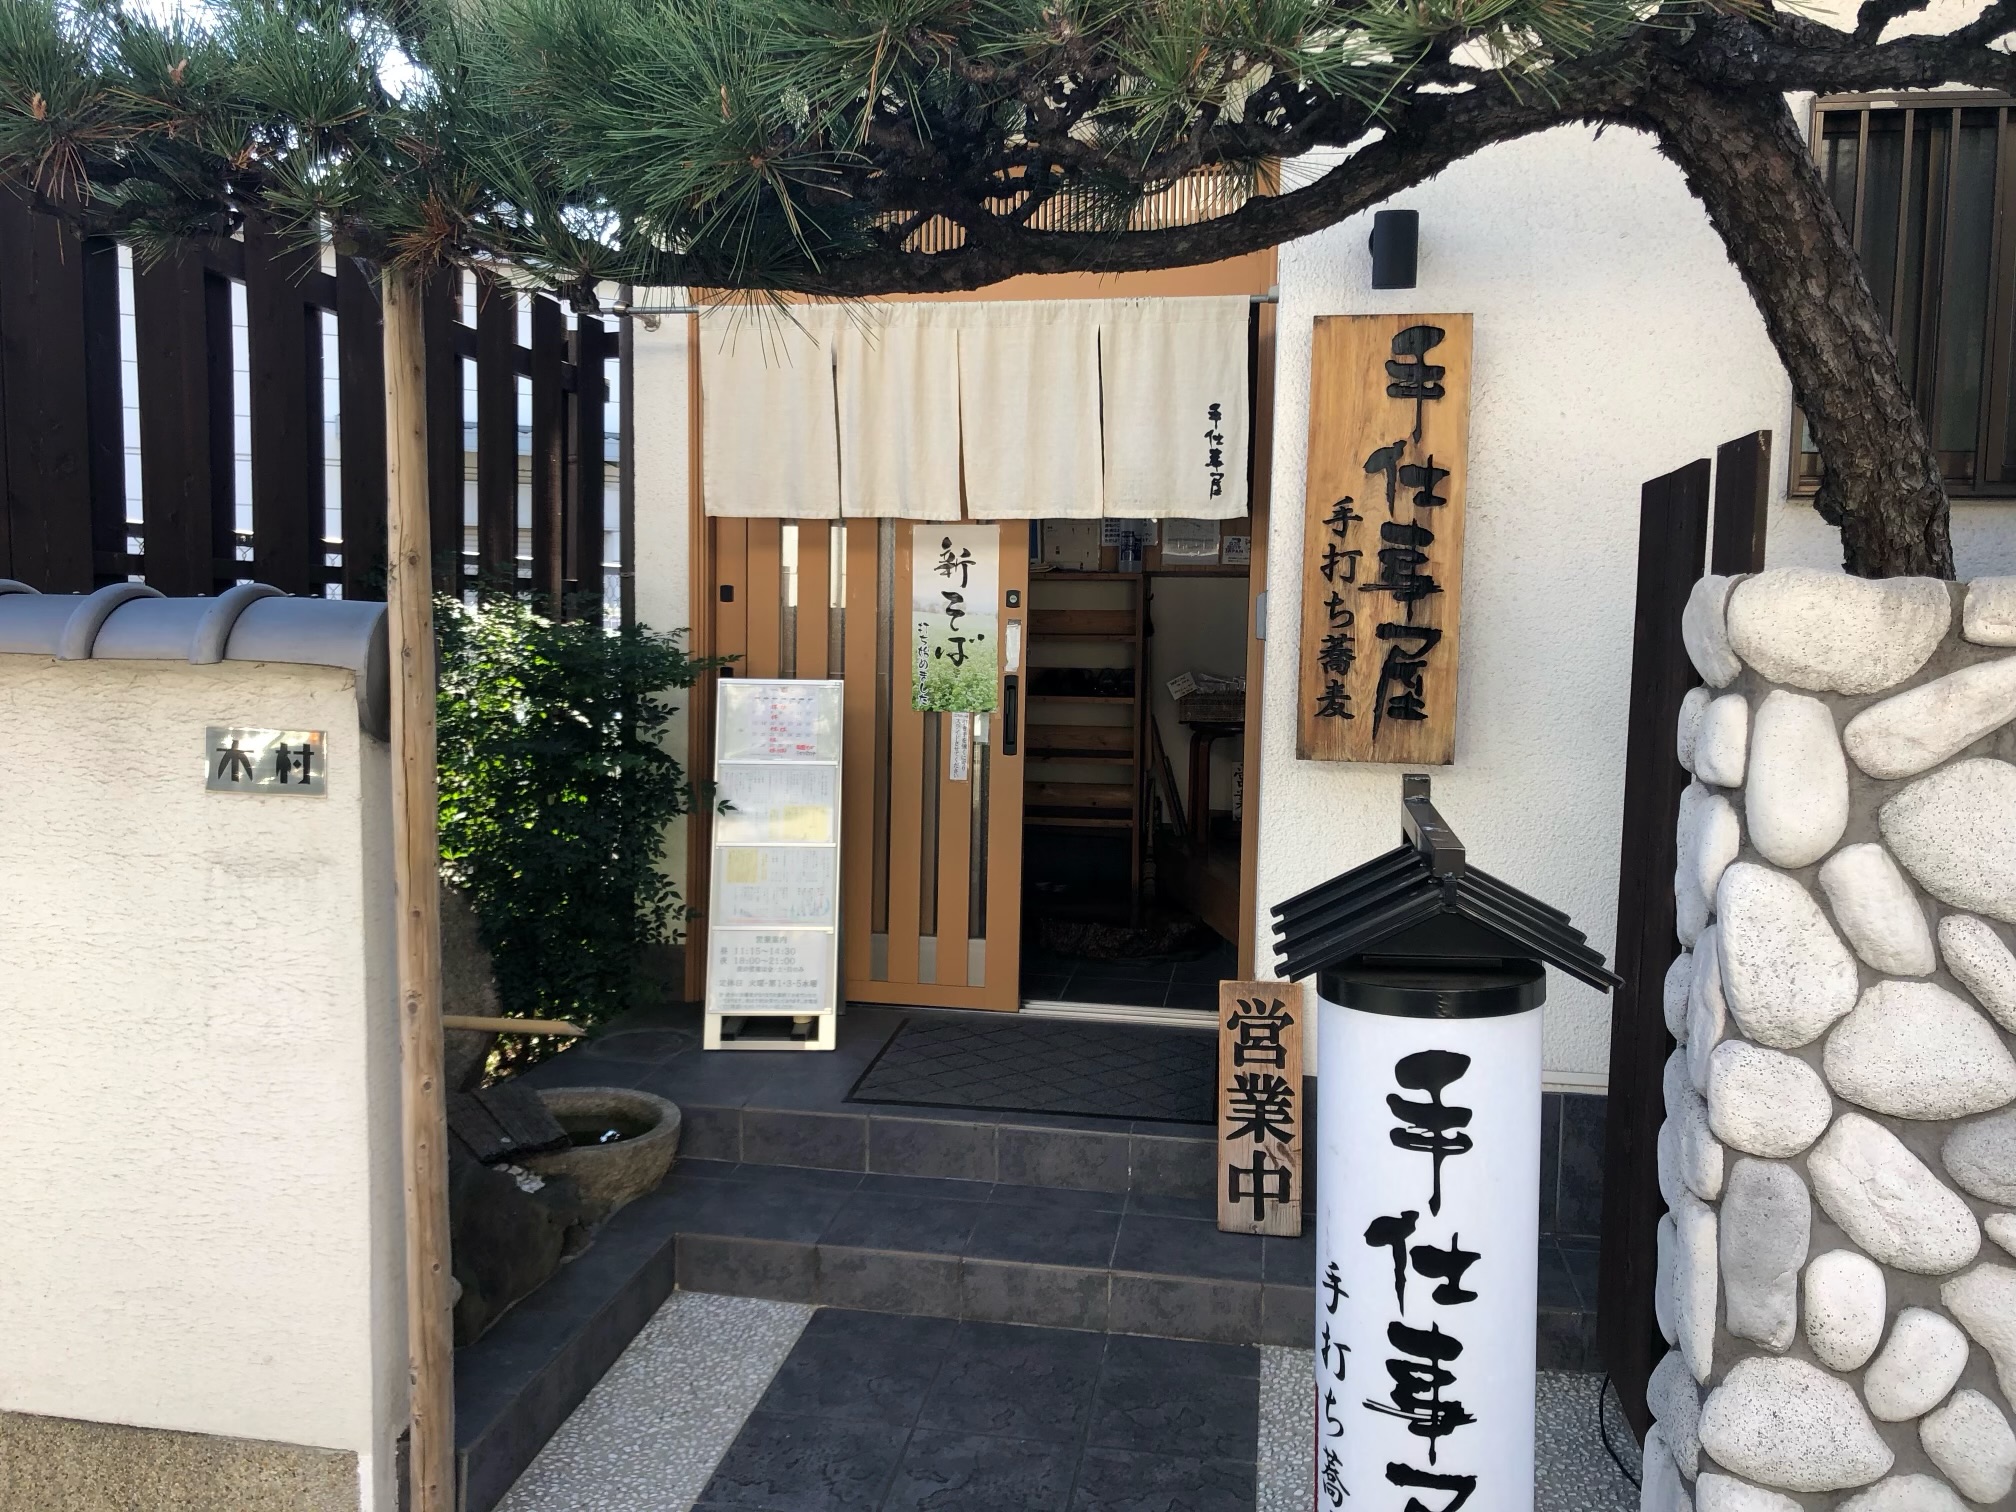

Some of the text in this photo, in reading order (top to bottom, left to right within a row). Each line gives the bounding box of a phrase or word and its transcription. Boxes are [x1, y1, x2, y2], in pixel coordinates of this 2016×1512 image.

[1203, 403, 1225, 500] 手仕事屋
[1357, 325, 1451, 741] 手仕事屋
[933, 536, 985, 667] 新そば
[1313, 495, 1364, 720] 手打ち蕎麦
[215, 739, 315, 785] 木村
[1225, 997, 1297, 1222] 営業中
[1321, 1262, 1353, 1512] 手打ち蕎
